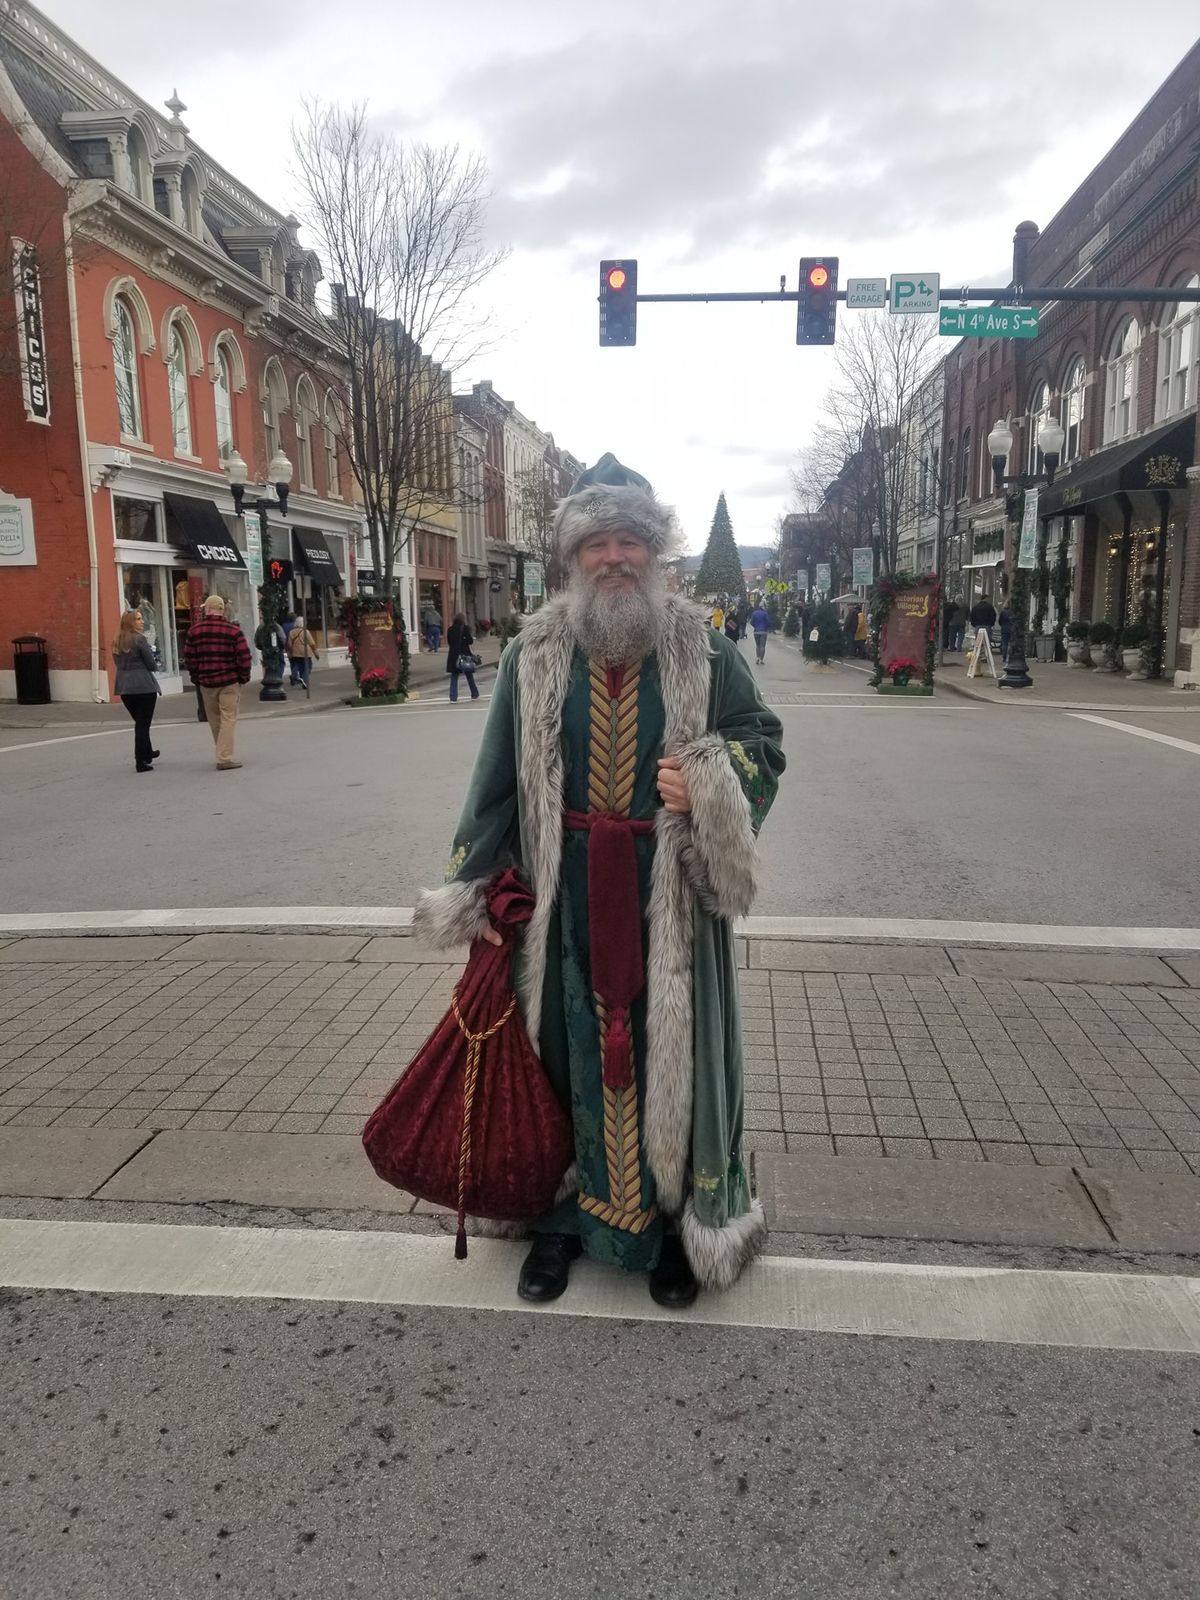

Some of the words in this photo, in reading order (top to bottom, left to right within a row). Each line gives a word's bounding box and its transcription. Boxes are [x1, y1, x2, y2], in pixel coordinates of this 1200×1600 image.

[856, 283, 877, 292] FREE
[850, 294, 882, 303] GARAGE
[957, 315, 965, 329] N
[970, 314, 985, 329] 4th
[986, 314, 1008, 330] Ave
[1013, 315, 1021, 330] S
[197, 544, 238, 562] CHICO'S
